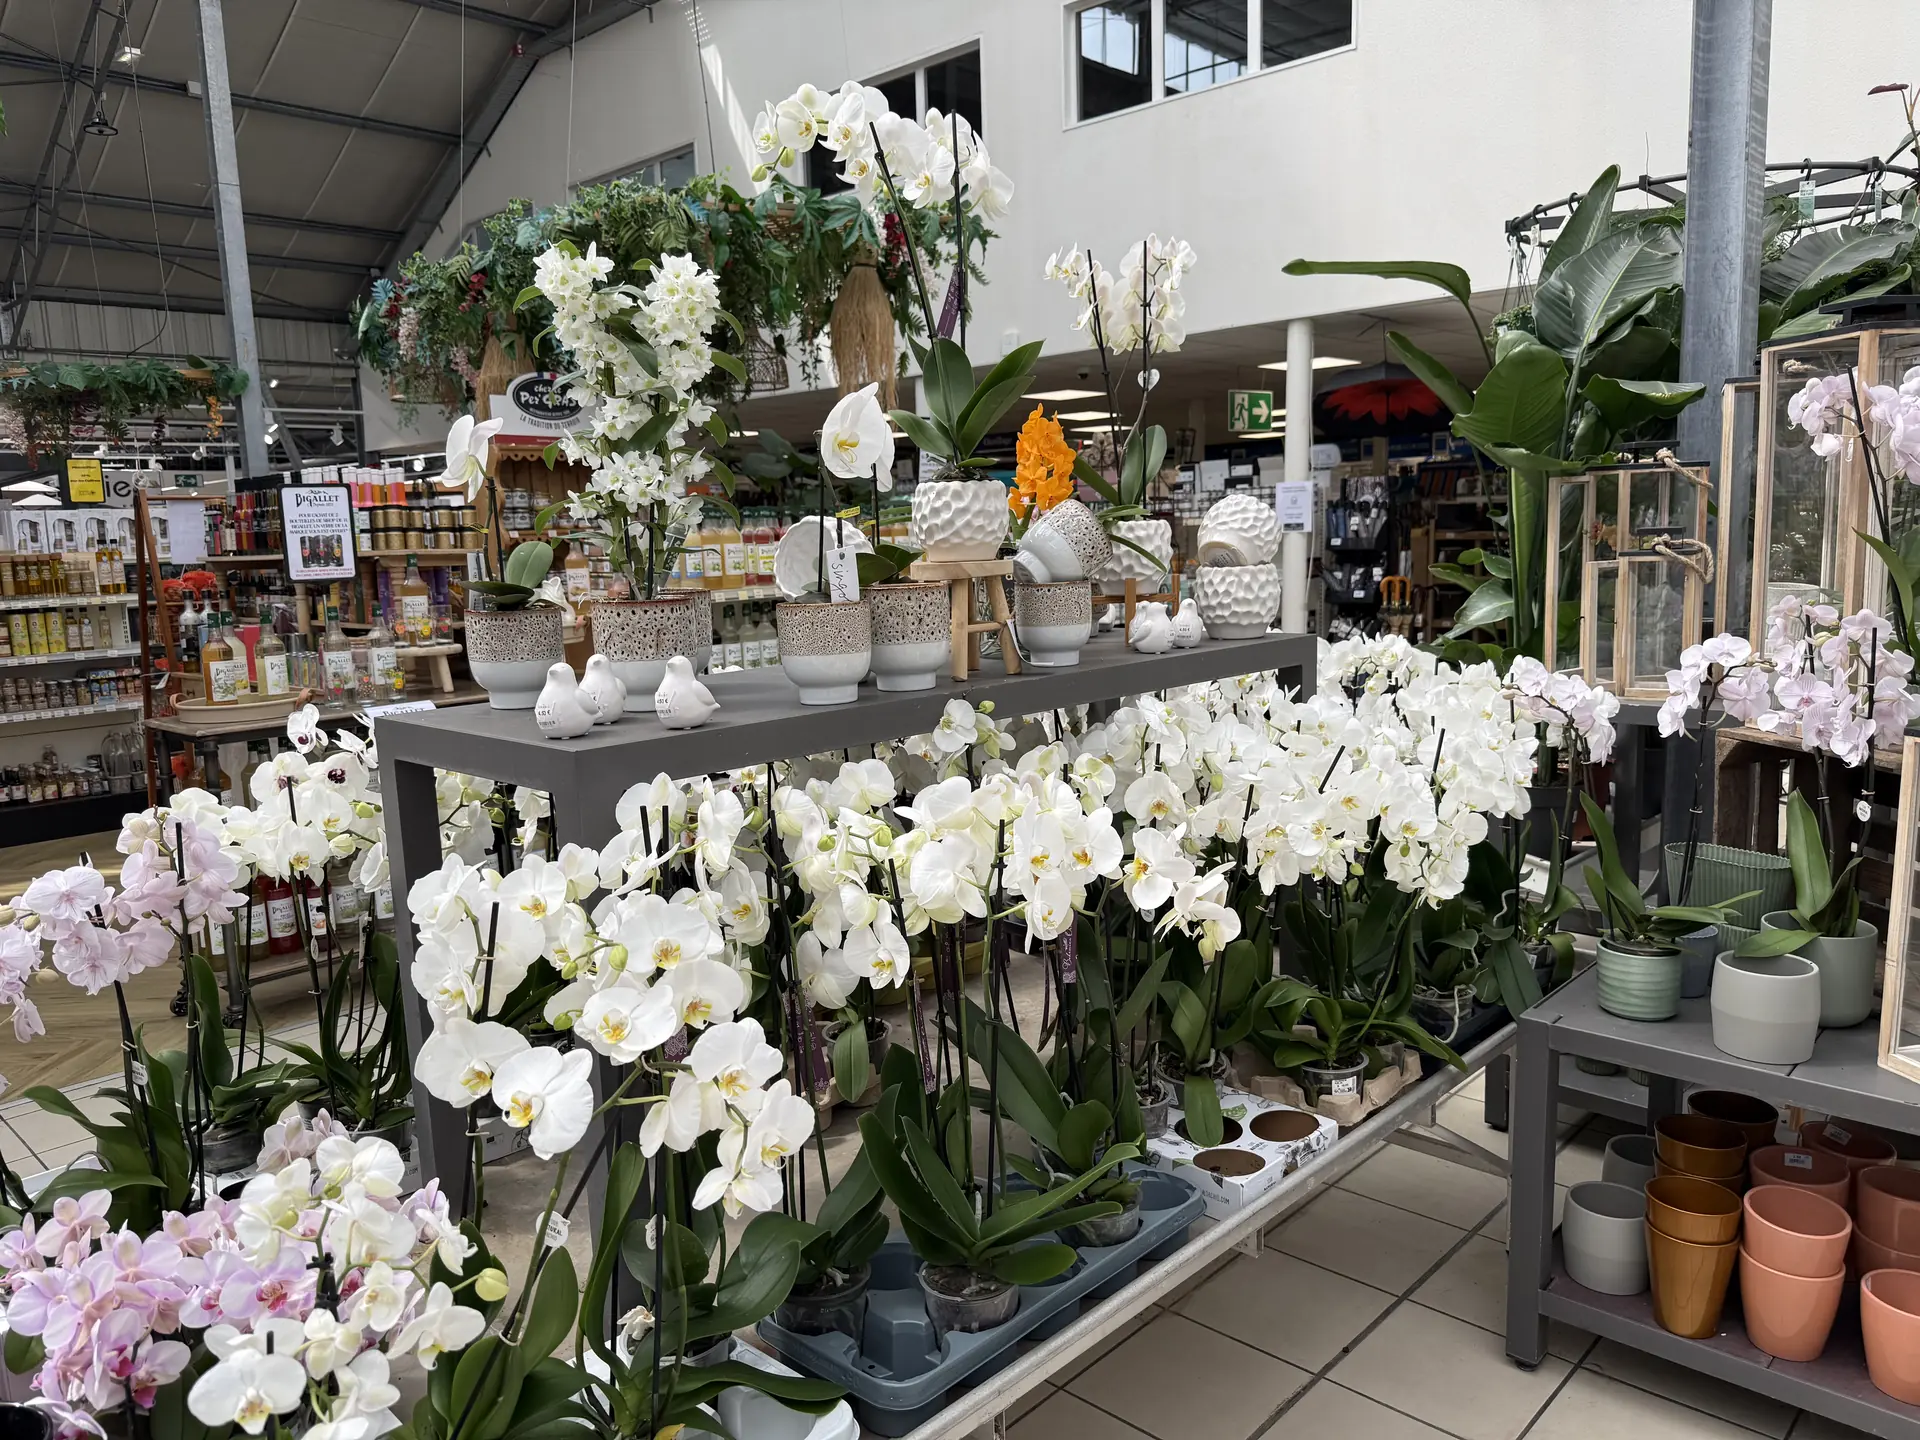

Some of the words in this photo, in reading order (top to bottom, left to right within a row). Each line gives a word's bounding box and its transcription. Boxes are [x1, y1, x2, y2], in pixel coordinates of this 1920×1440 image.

[534, 384, 552, 393] chez
[527, 417, 553, 429] TRADITION
[561, 417, 580, 429] TERROIR
[295, 493, 339, 507] BIGALLET
